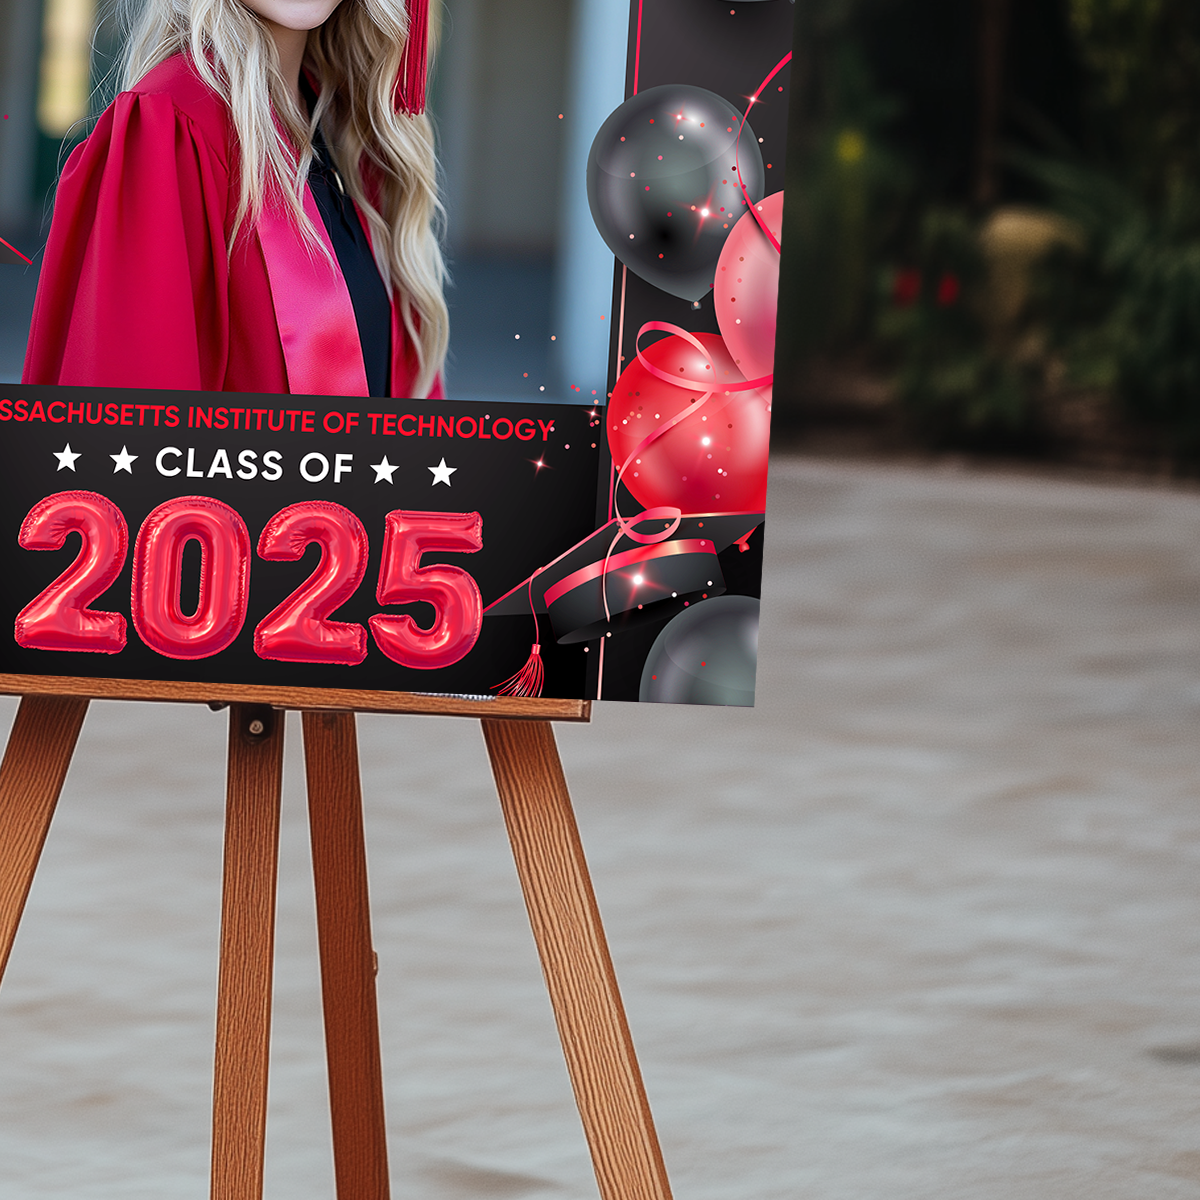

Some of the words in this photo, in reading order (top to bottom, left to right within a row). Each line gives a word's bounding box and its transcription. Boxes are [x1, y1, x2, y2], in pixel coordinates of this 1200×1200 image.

[187, 406, 316, 433] INSTITUTE
[322, 411, 360, 434] OF
[367, 412, 555, 442] TECHNOLOGY
[155, 446, 283, 481] CLASS
[299, 452, 354, 484] OF
[14, 489, 484, 670] 2025
